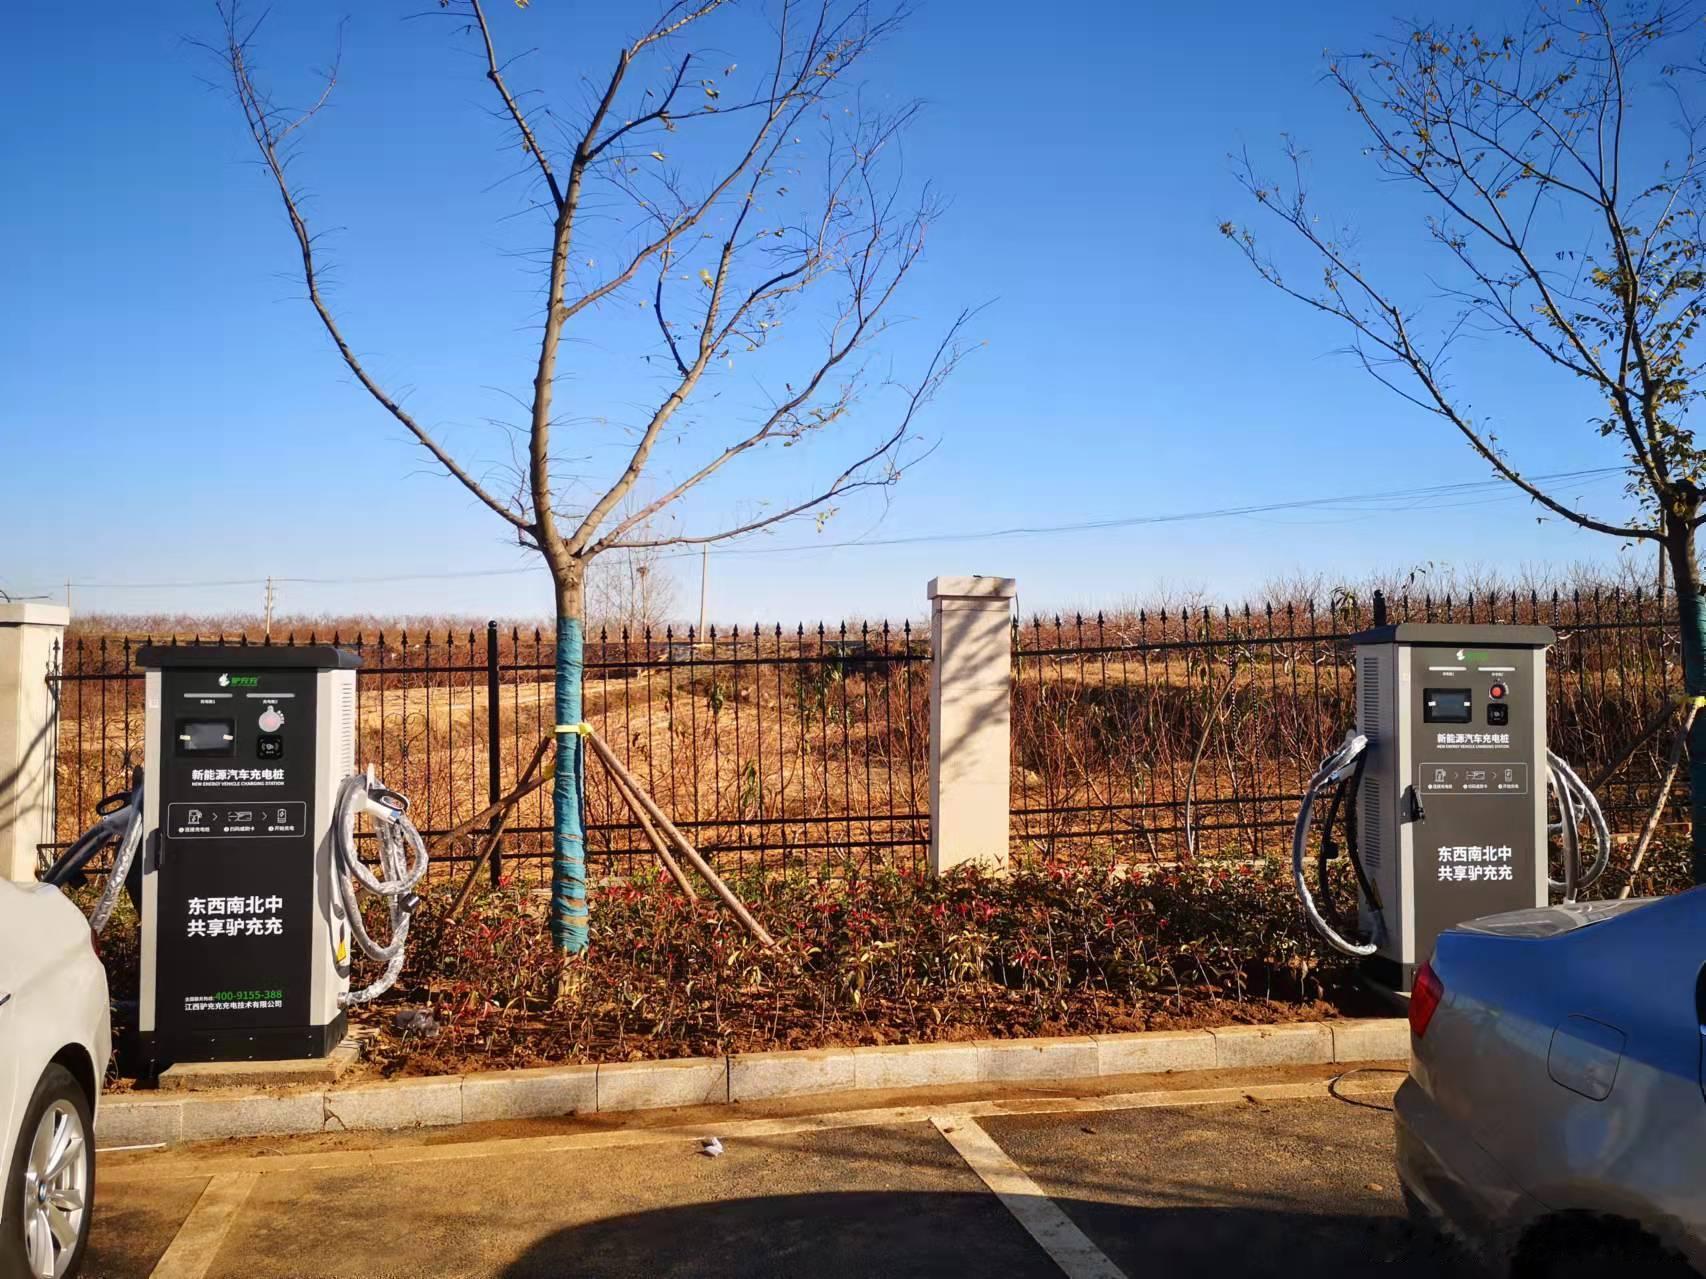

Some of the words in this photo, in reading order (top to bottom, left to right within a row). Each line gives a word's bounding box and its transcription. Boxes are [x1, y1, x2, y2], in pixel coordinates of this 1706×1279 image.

[1437, 733, 1509, 744] 新能源汽车充电桩
[191, 768, 285, 780] 新能源汽车充电桩
[1437, 845, 1512, 862] 东西南北中
[1437, 864, 1513, 881] 共享驴充充
[187, 895, 283, 915] 东西南北中
[187, 917, 283, 937] 共享驴充充
[215, 990, 282, 1000] 400-9155-388
[185, 1000, 283, 1011] 江西驴充充充电技术有限公司
